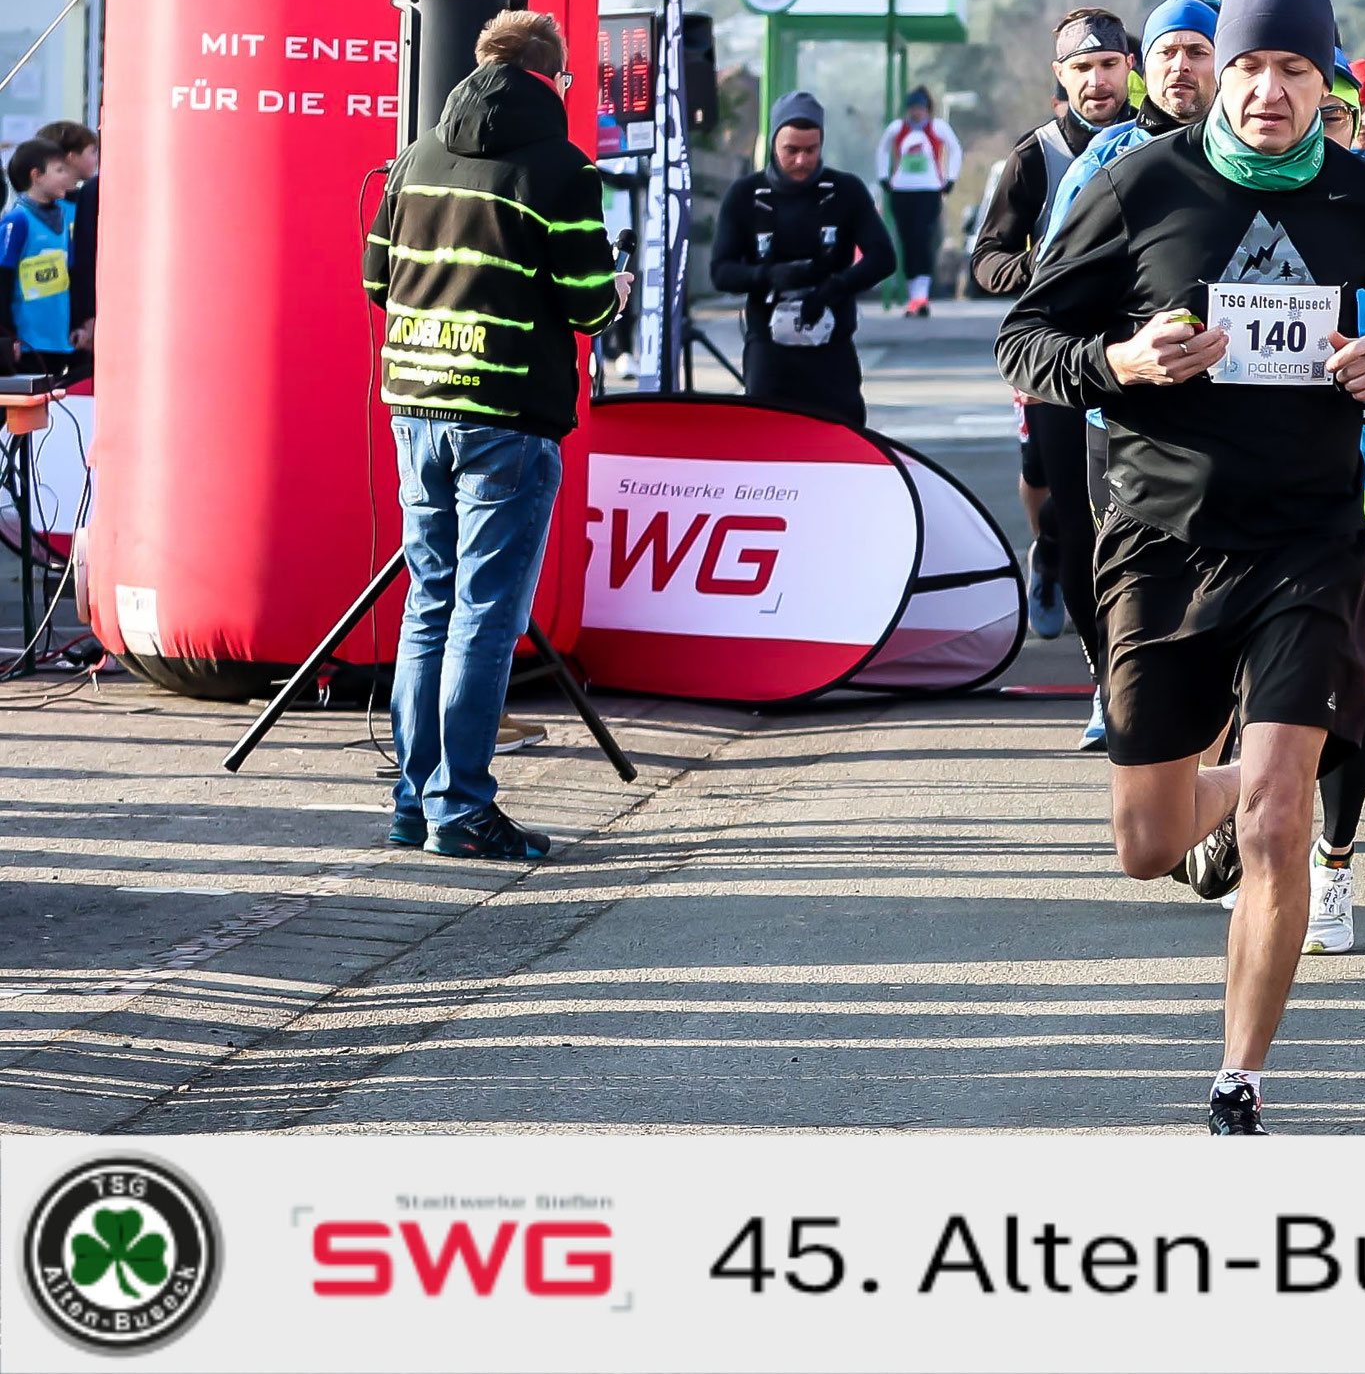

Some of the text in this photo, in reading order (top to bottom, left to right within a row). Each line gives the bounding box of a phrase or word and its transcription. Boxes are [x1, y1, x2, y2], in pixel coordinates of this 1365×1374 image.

[201, 32, 265, 57] MIT
[171, 78, 238, 111] FÜR
[258, 90, 325, 115] DIE
[1220, 294, 1332, 311] TSG Alten-Buseck
[388, 316, 487, 354] MODERATOR
[1246, 319, 1307, 353] 140
[1248, 361, 1310, 376] patterns
[618, 478, 799, 502] Stadtwerke Gießen
